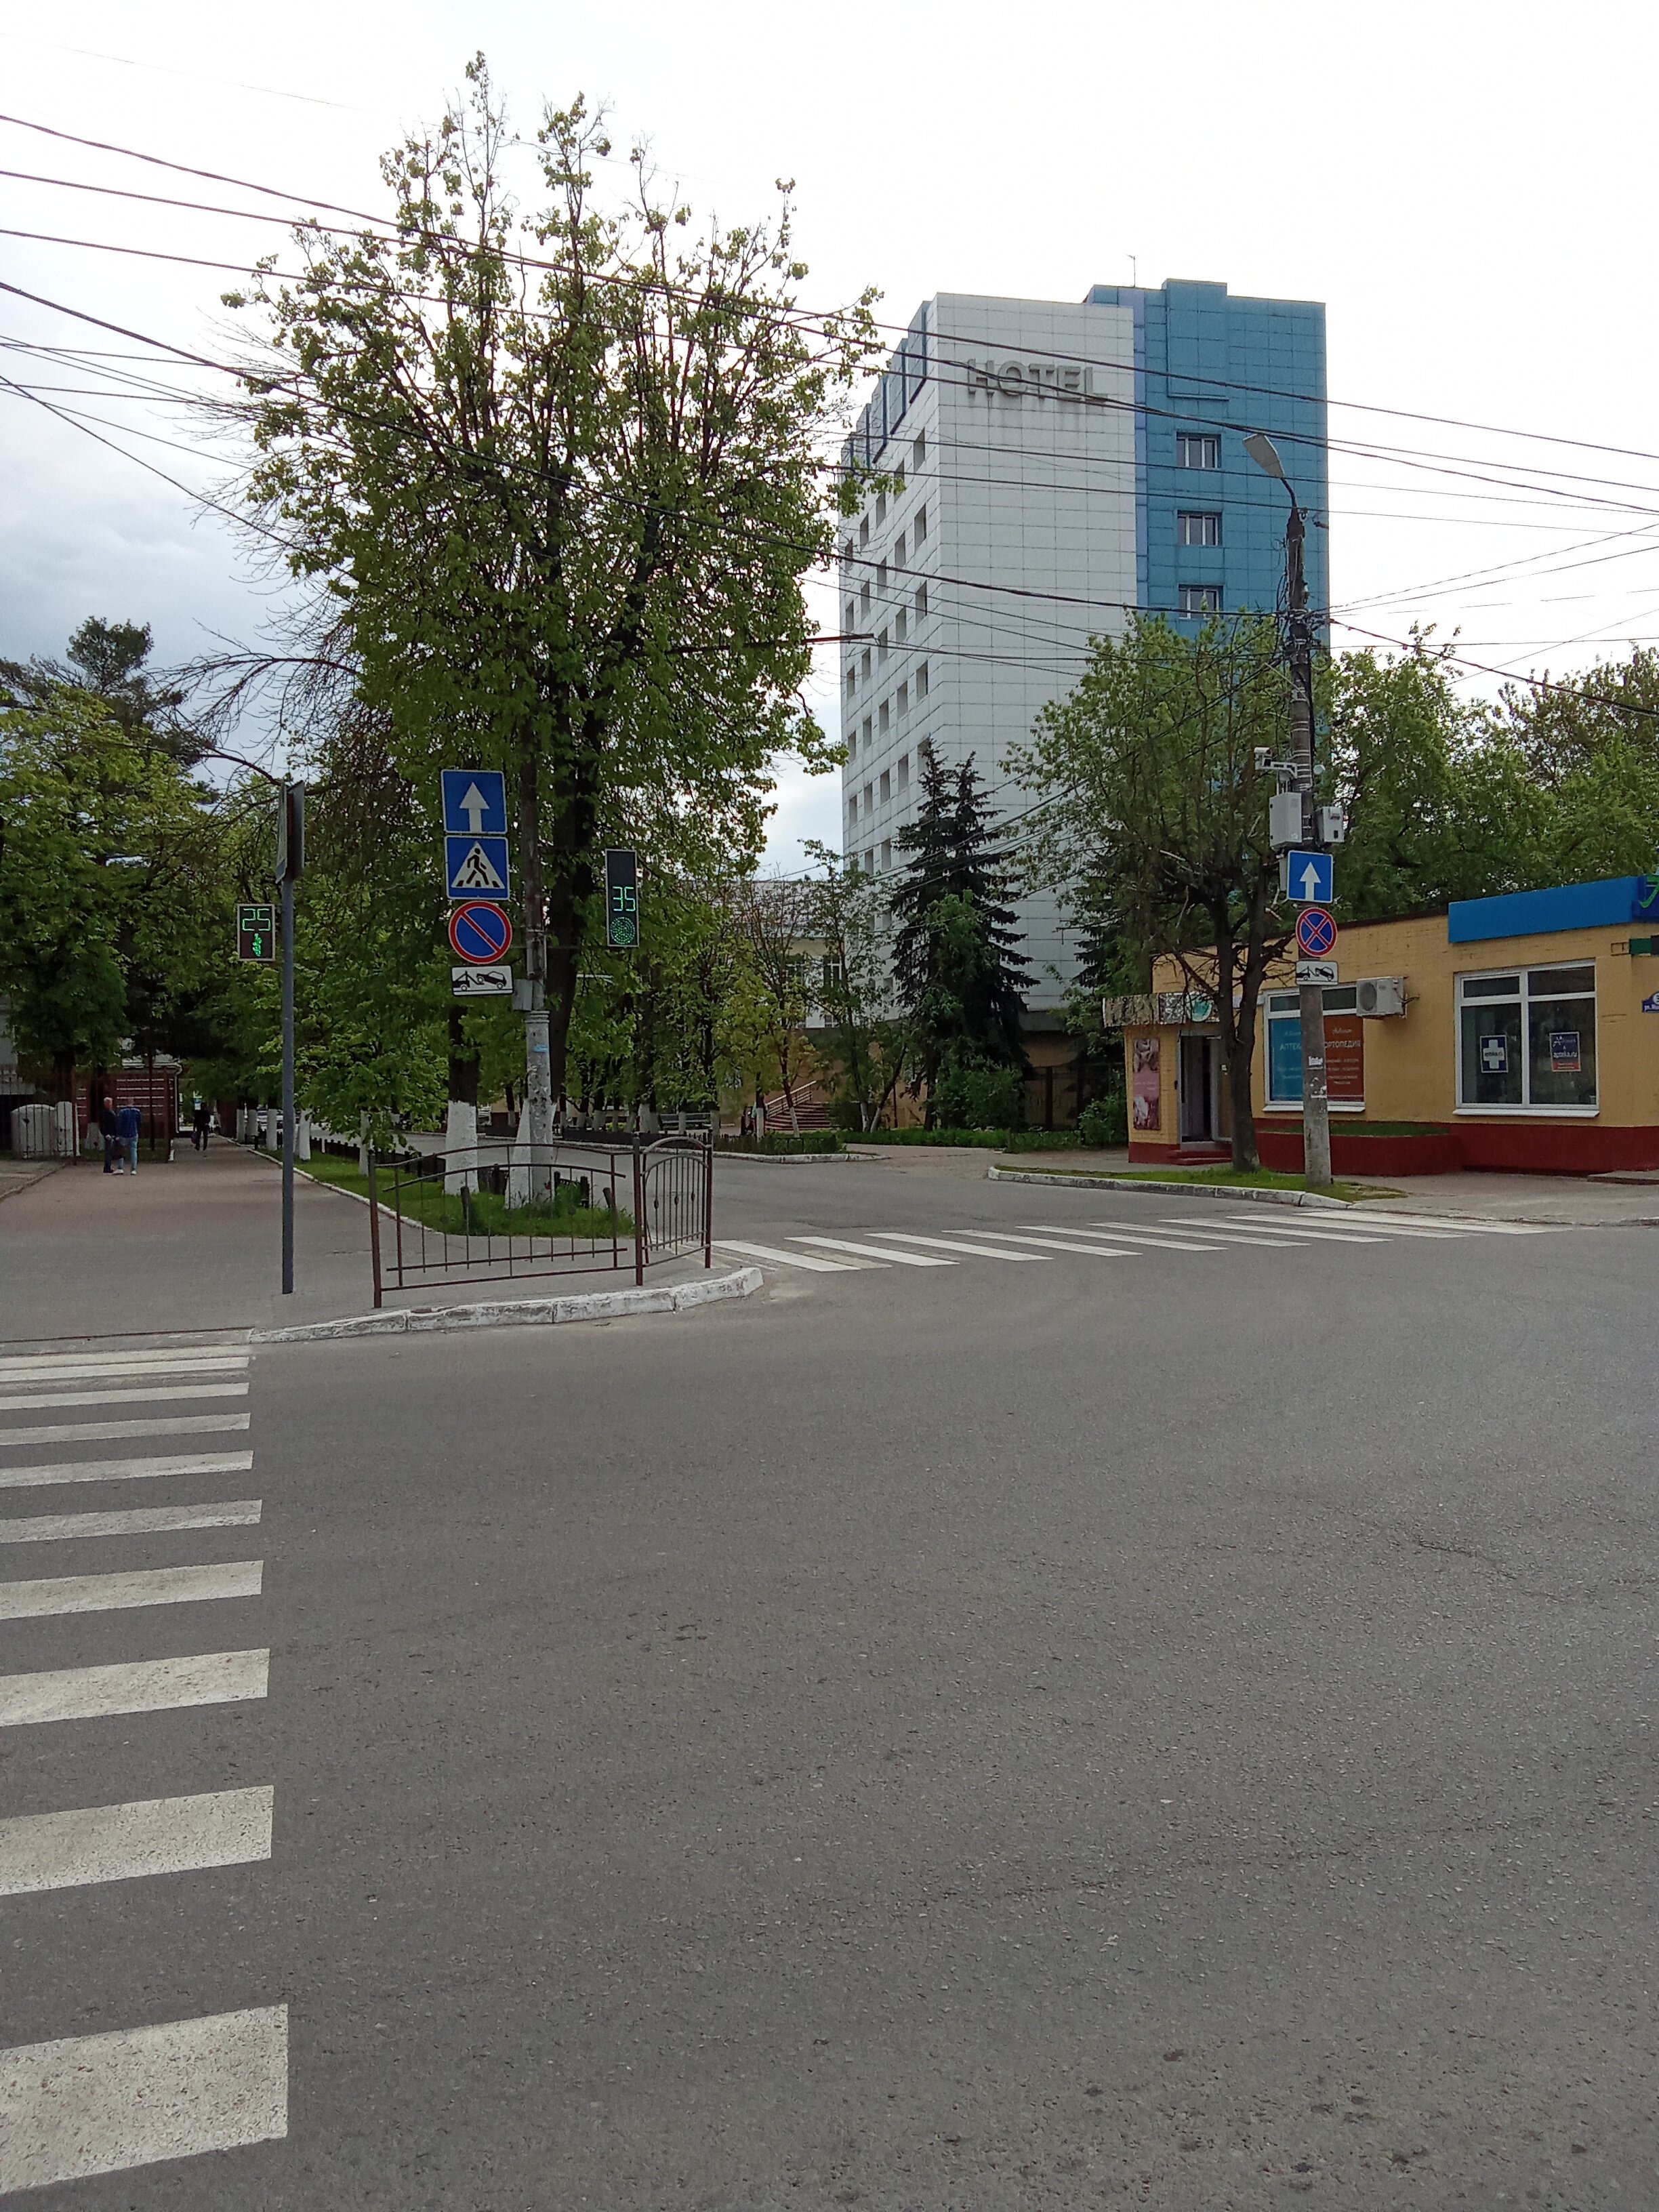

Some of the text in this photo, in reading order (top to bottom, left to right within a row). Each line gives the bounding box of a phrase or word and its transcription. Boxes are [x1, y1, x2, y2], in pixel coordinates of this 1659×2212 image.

[967, 358, 1108, 403] HOTEL
[612, 886, 636, 912] 35
[242, 907, 271, 931] 25
